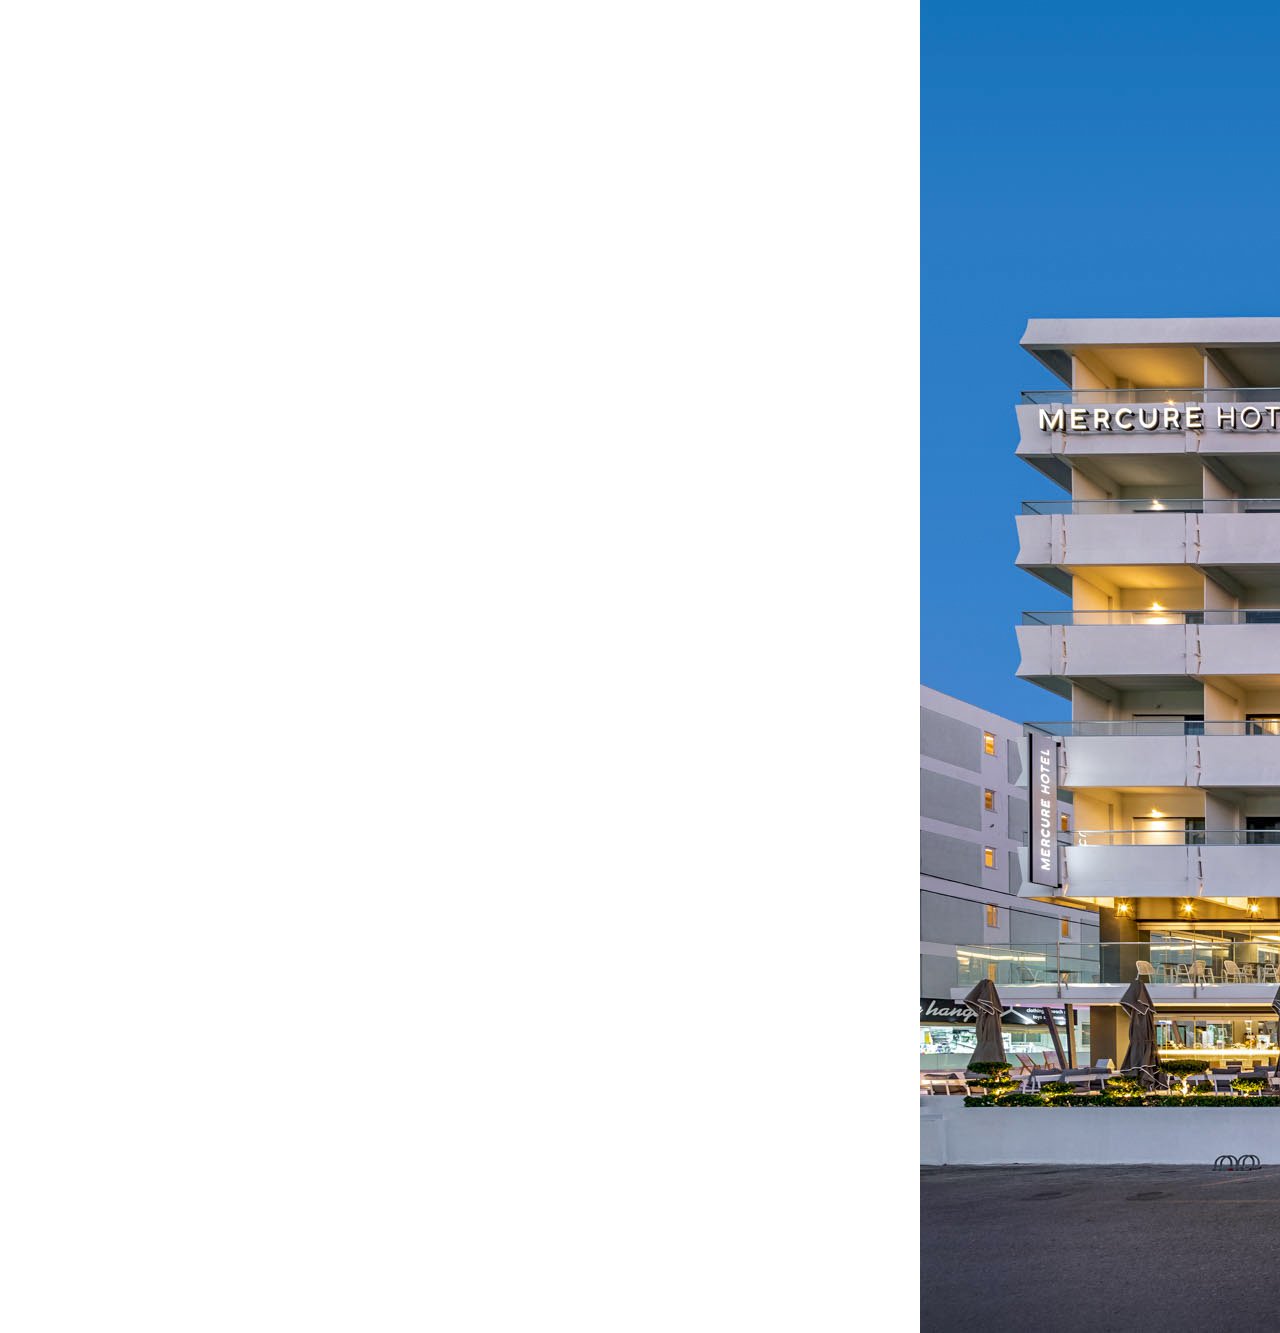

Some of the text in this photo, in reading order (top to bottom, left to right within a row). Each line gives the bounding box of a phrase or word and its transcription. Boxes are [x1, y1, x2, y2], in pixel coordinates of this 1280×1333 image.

[1038, 406, 1203, 431] MERCURE
[1040, 749, 1051, 871] MERCURE HOTEL
